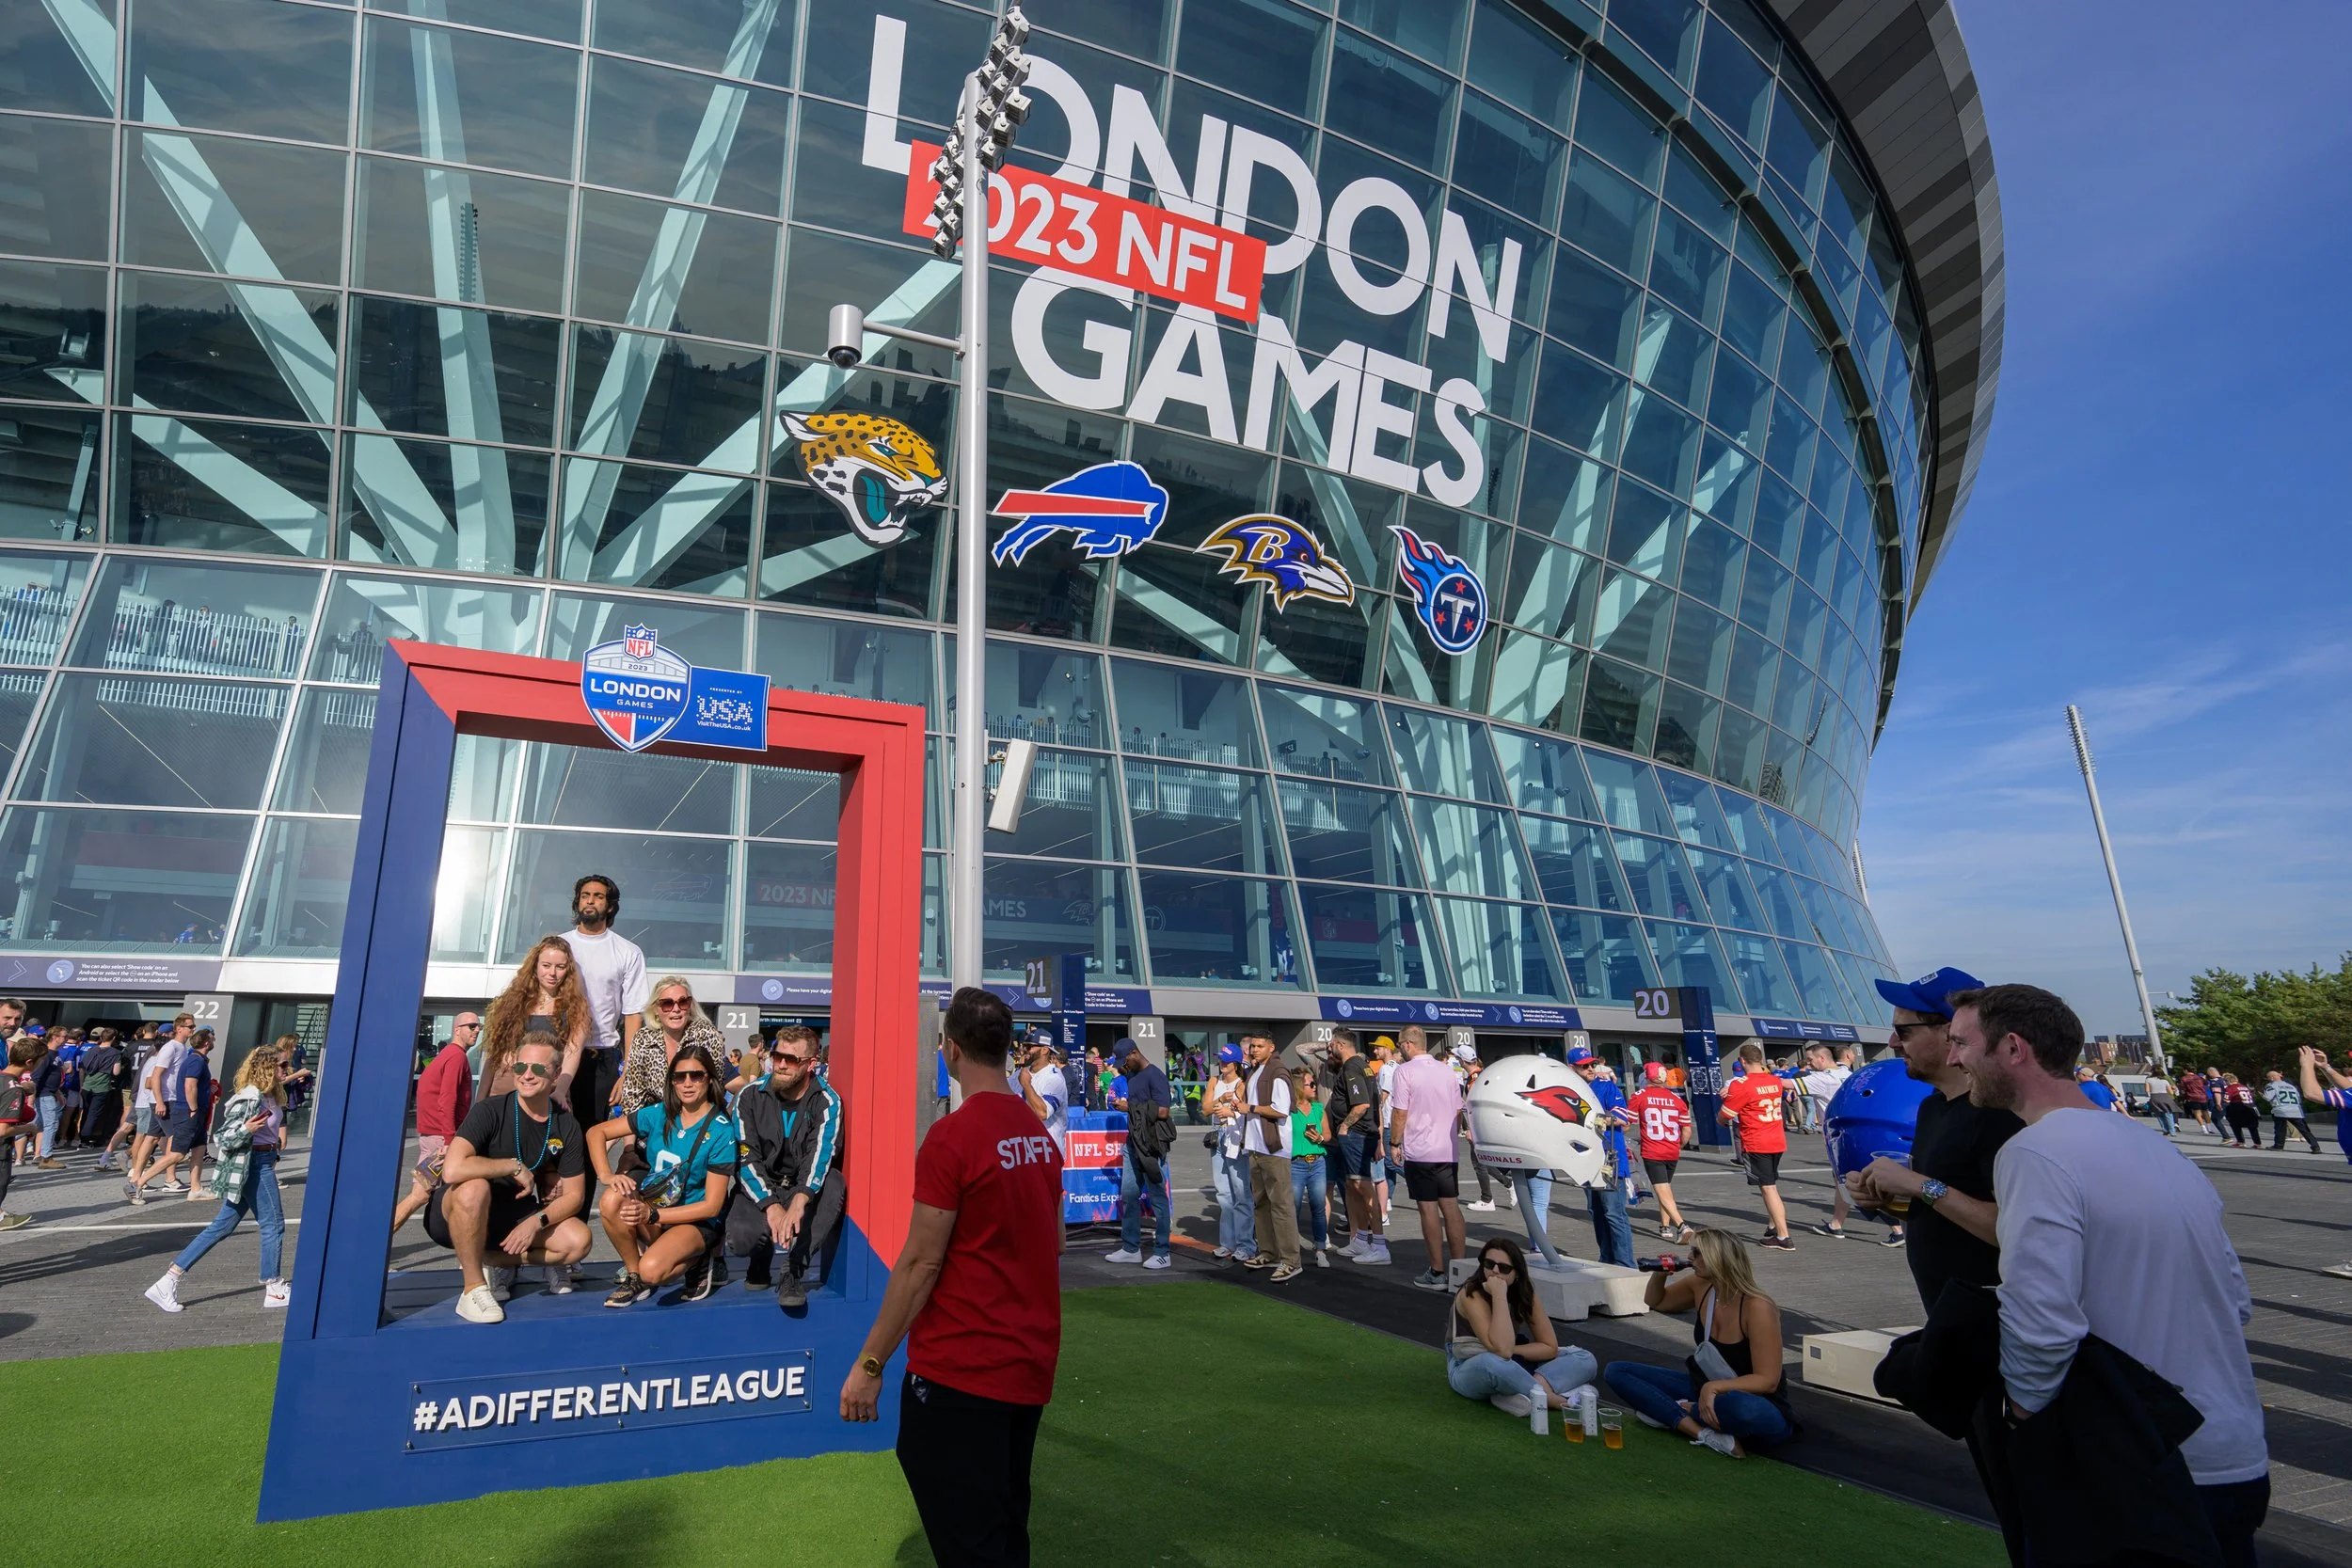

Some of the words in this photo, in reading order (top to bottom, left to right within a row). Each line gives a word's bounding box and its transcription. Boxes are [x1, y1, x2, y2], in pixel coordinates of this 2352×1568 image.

[862, 14, 1524, 364] LONDON
[1116, 210, 1247, 310] NFL
[1011, 265, 1486, 508] GAMES
[627, 640, 652, 657] NFL
[628, 663, 648, 672] 2023
[590, 677, 681, 702] LONDON
[616, 699, 654, 709] GAMES
[760, 884, 806, 904] 2023
[811, 888, 836, 905] NF
[1025, 960, 1046, 993] 21
[194, 1001, 219, 1020] 22
[1635, 990, 1670, 1016] 20
[725, 1012, 749, 1029] 21
[1137, 1022, 1156, 1037] 21
[1317, 1027, 1332, 1042] 20
[1457, 1032, 1470, 1045] 20
[1573, 1036, 1585, 1048] 20
[1647, 1097, 1676, 1107] KITTLE
[2279, 1091, 2298, 1104] 25
[1758, 1098, 1782, 1122] 32
[1645, 1107, 1680, 1142] 85
[997, 1136, 1054, 1170] STAFF
[1074, 1143, 1103, 1157] NFL
[1104, 1143, 1123, 1156] SH
[1477, 1153, 1522, 1164] CARDINALS
[413, 1366, 805, 1433] #ADIFFERENTLEAGUE
